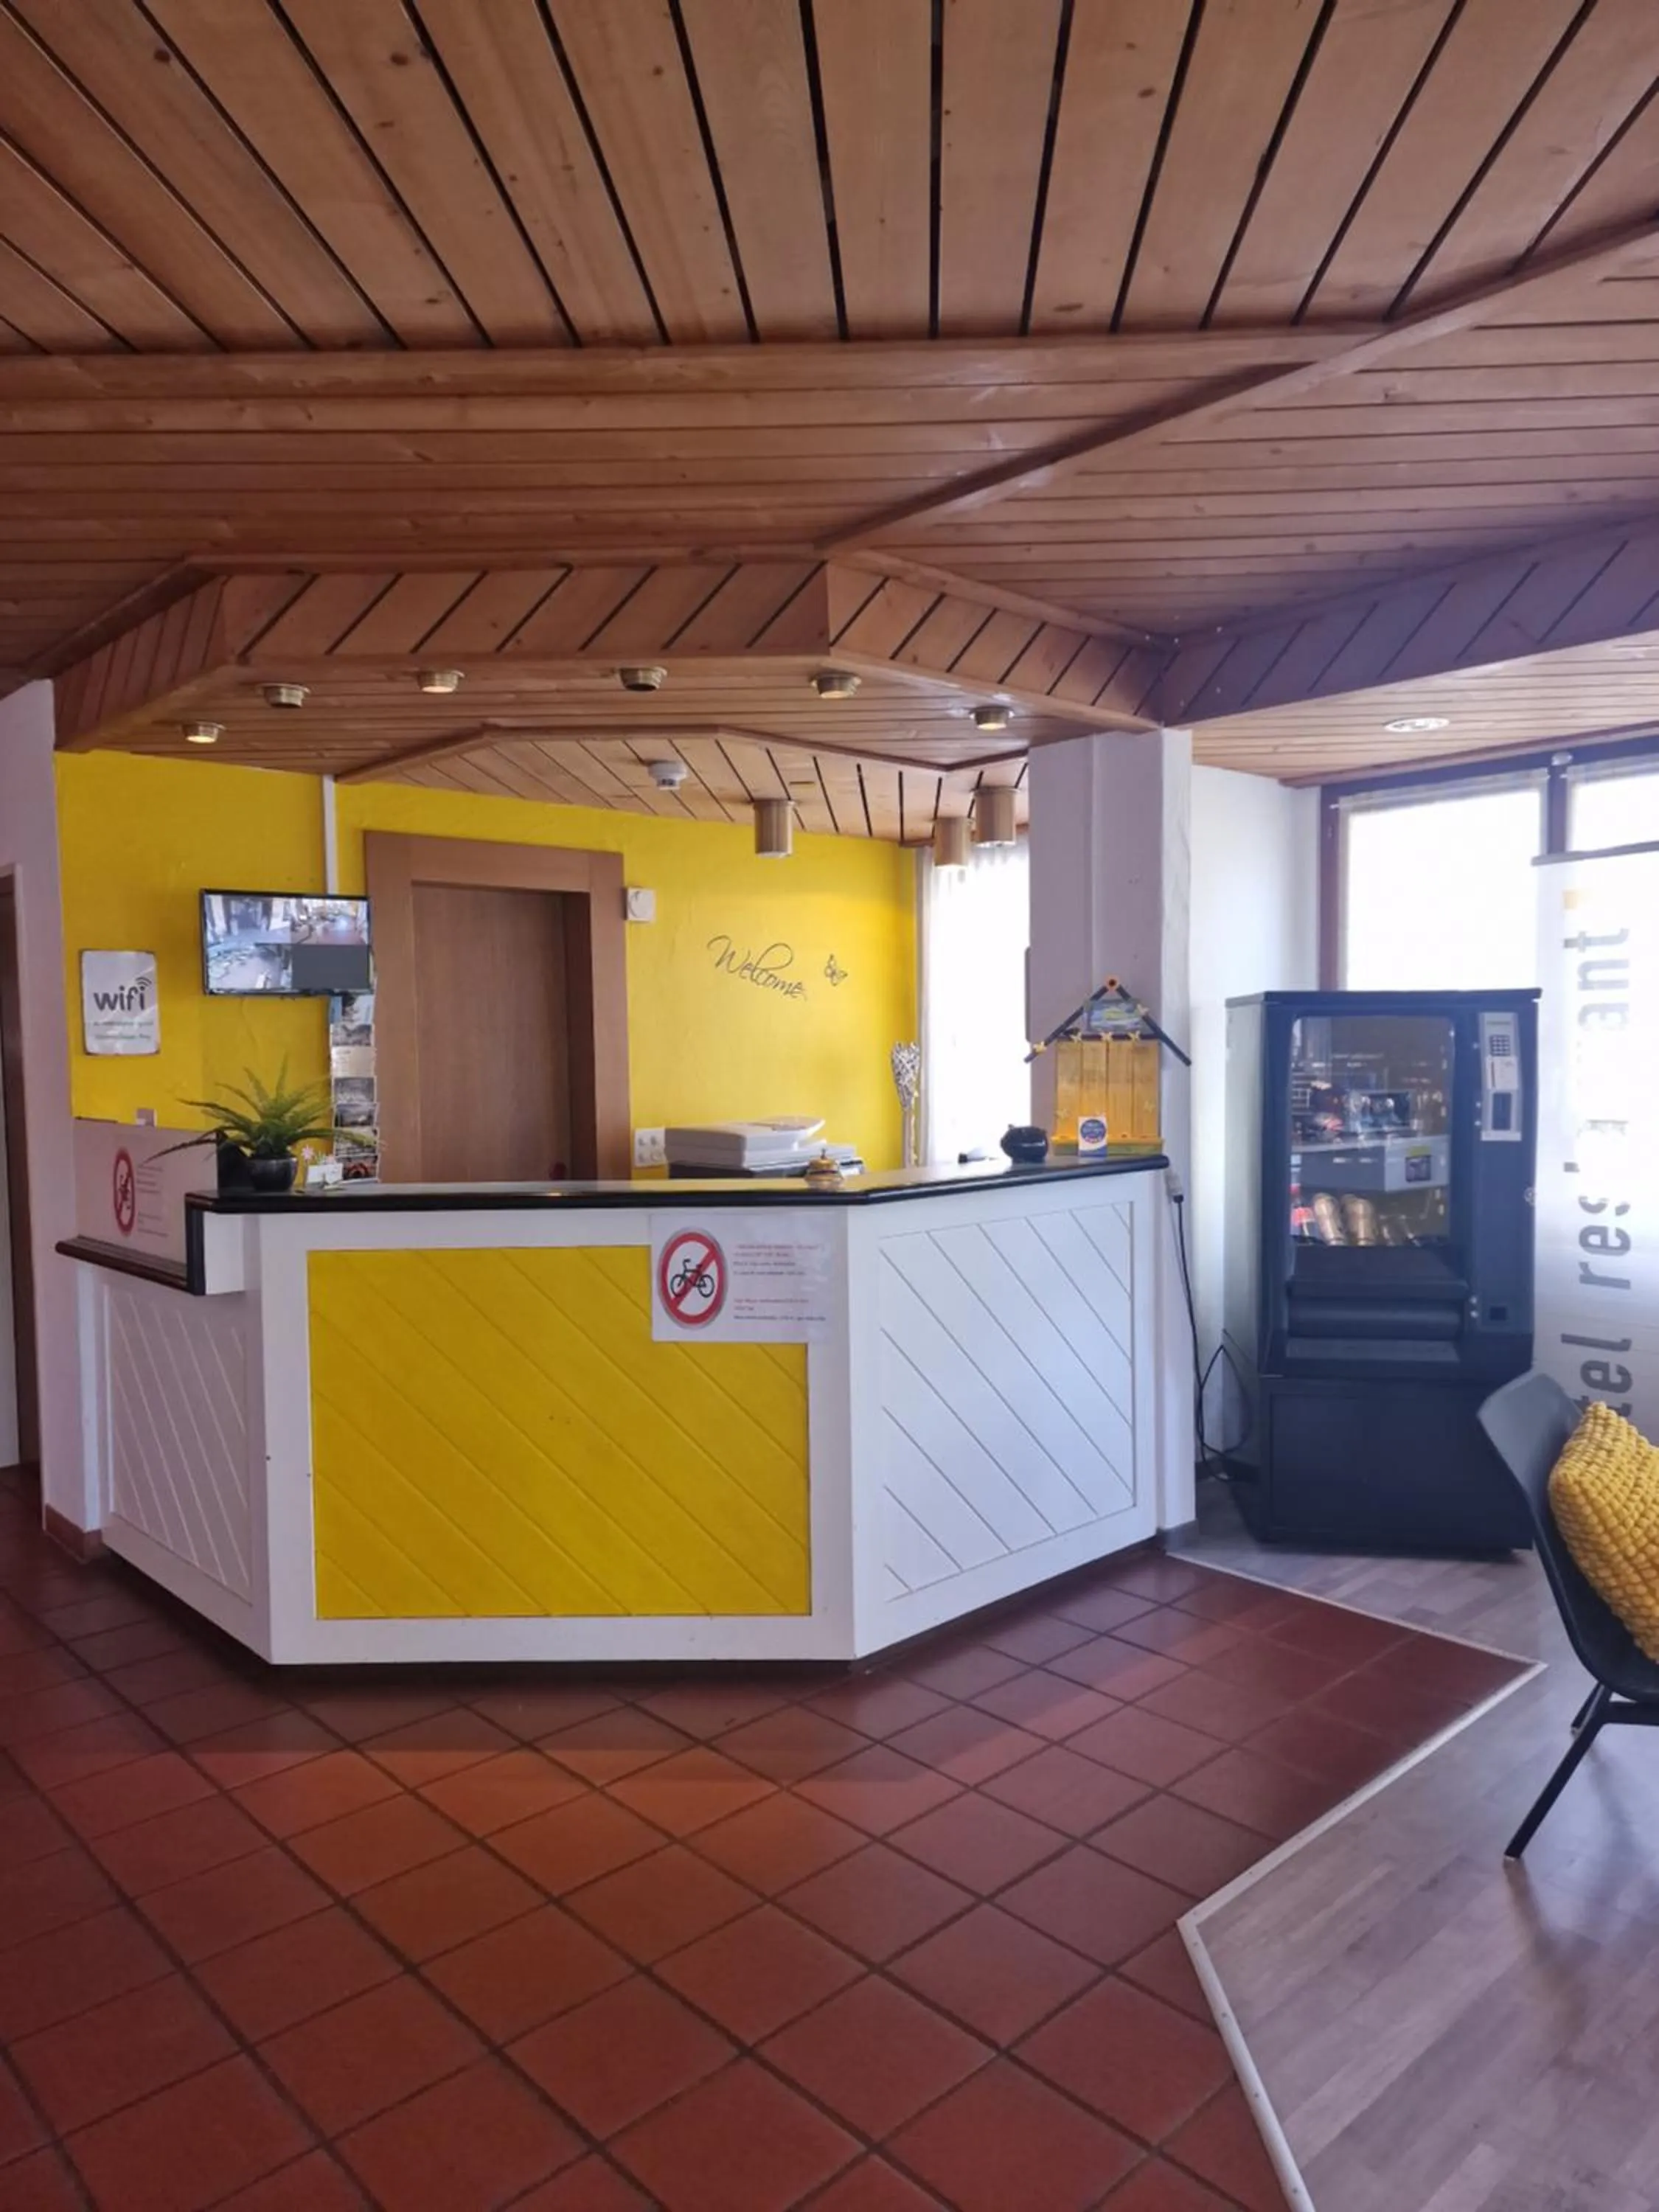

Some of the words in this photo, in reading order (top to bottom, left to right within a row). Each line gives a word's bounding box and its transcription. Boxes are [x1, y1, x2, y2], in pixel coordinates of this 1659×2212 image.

[94, 985, 146, 1012] wifi
[706, 934, 807, 1001] Welcome
[1563, 928, 1631, 1290] resant
